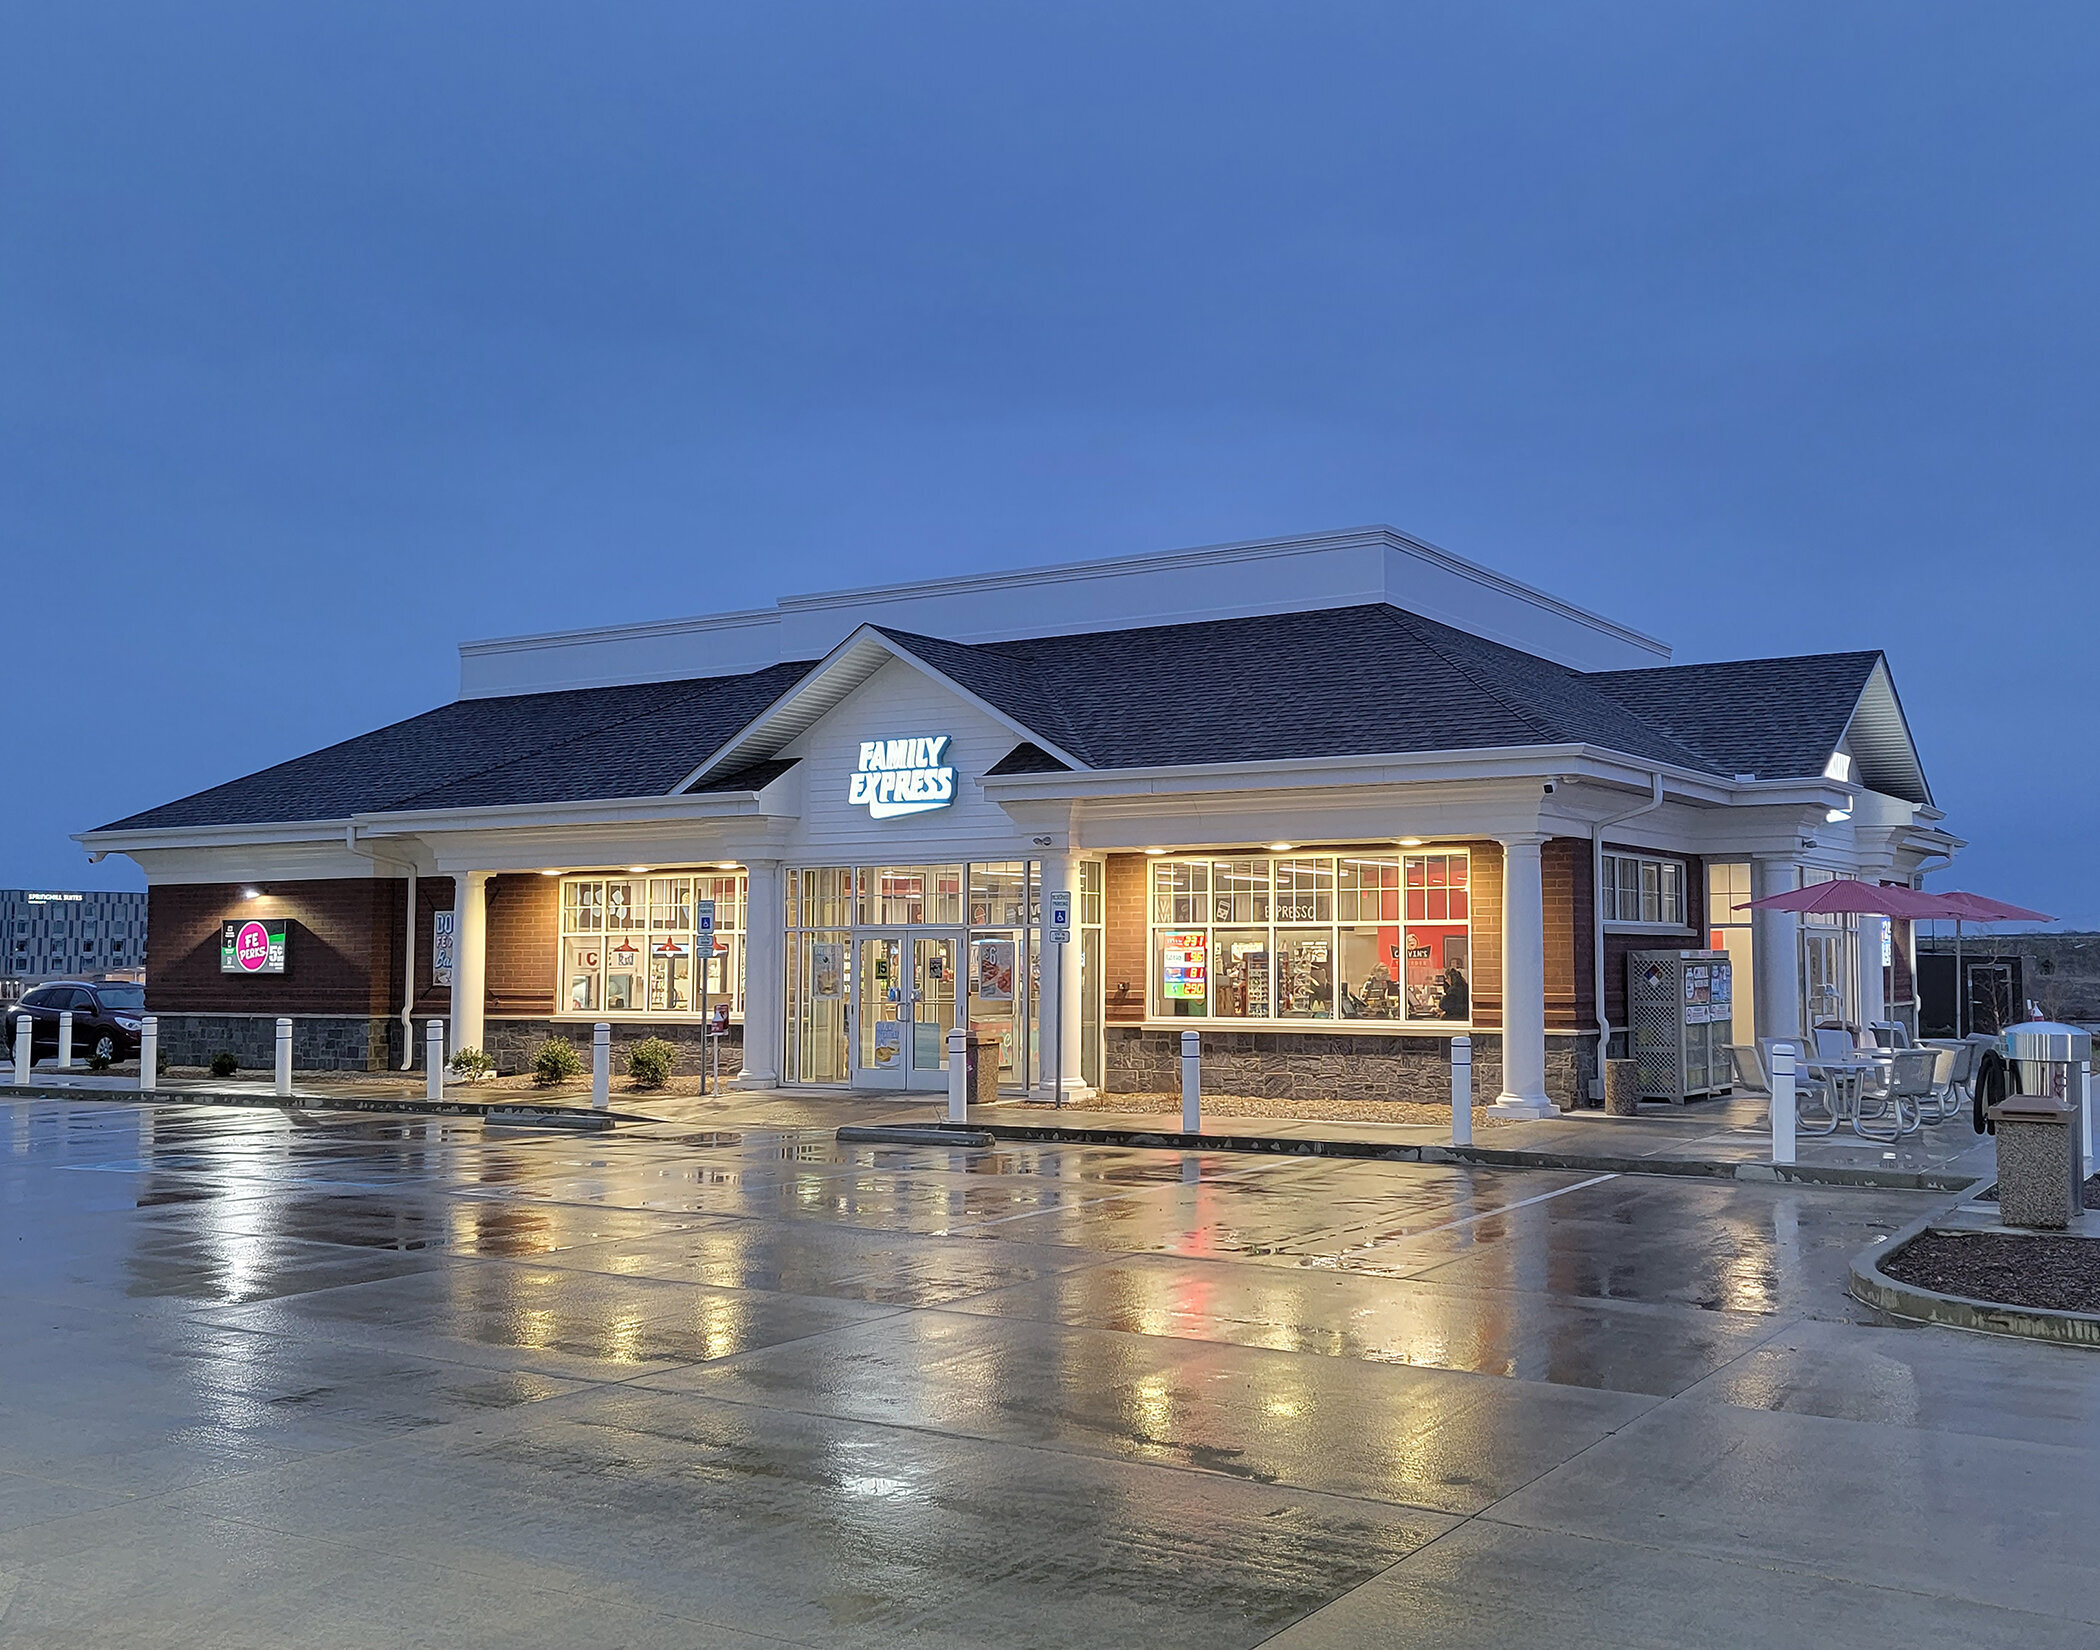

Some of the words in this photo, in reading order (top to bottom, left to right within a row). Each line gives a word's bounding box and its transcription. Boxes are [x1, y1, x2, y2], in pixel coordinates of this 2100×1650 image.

[859, 736, 948, 772] FAMILY
[849, 767, 954, 804] EXPRESS
[1264, 905, 1315, 919] EPRESSO
[245, 932, 259, 948] FE
[240, 946, 267, 960] PERKS
[1394, 950, 1428, 958] CVIN'S
